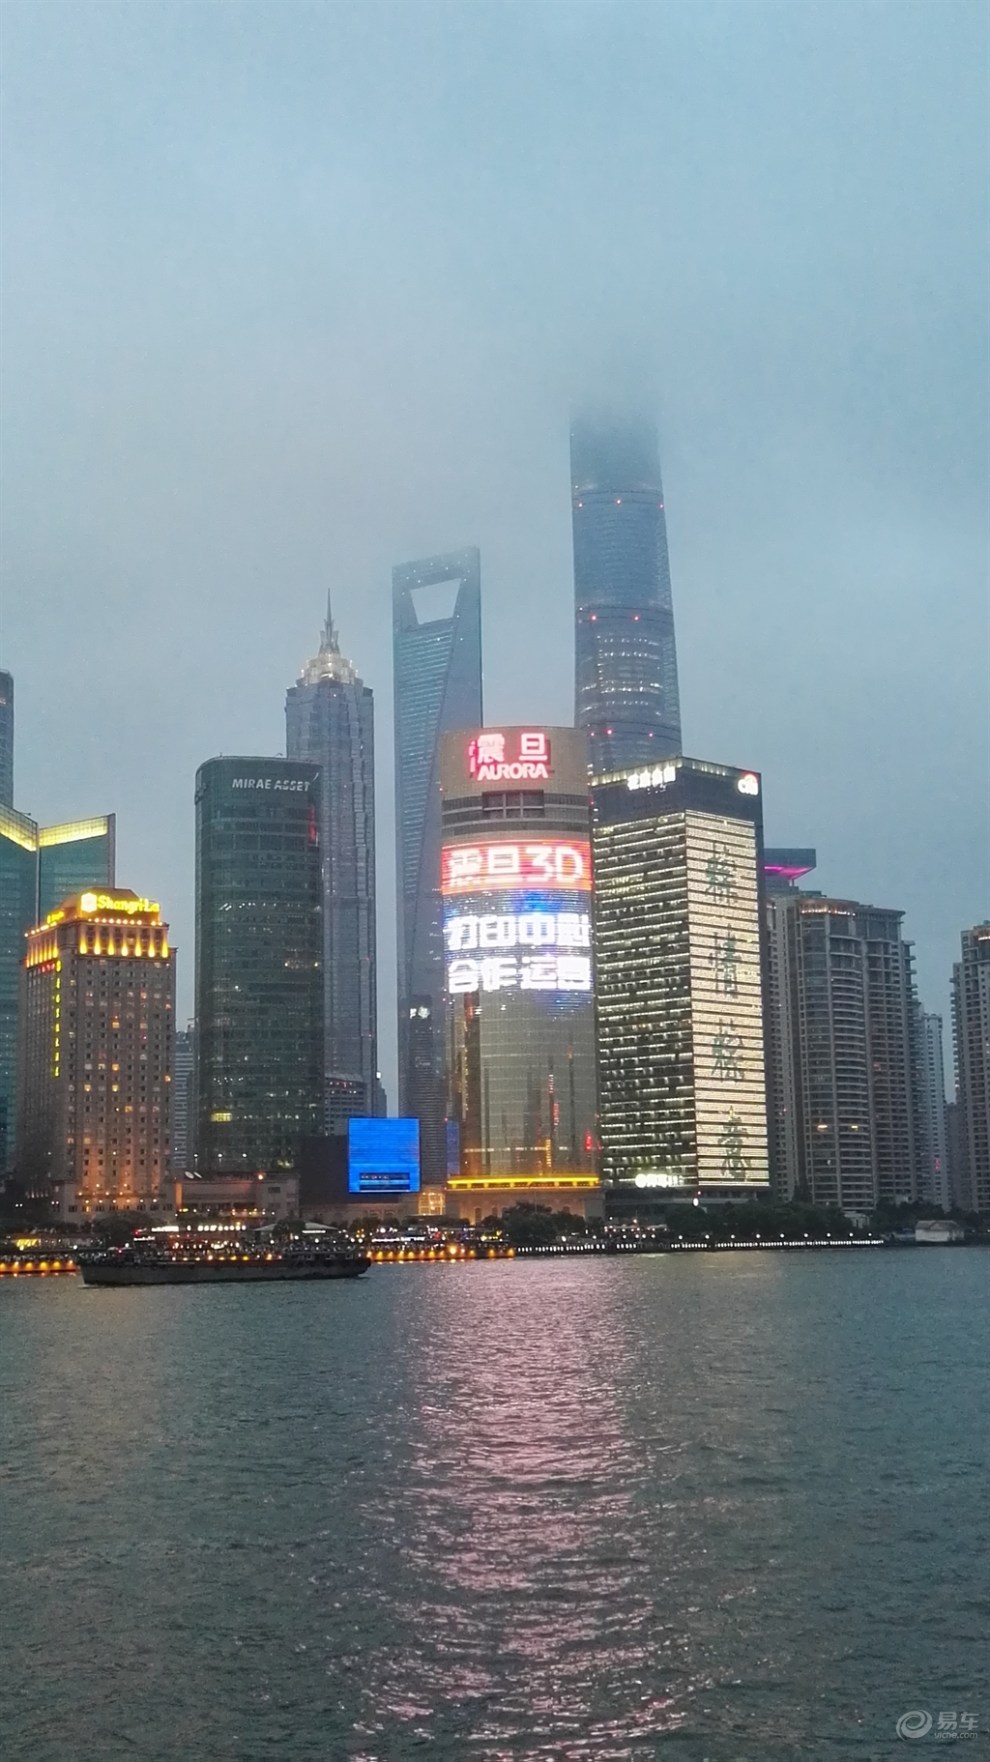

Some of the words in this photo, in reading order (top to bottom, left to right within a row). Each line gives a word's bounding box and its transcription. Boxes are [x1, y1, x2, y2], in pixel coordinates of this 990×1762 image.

[477, 732, 548, 764] 震旦
[476, 763, 549, 781] AURORA
[232, 778, 272, 790] MIRAE
[274, 779, 311, 792] ASSET
